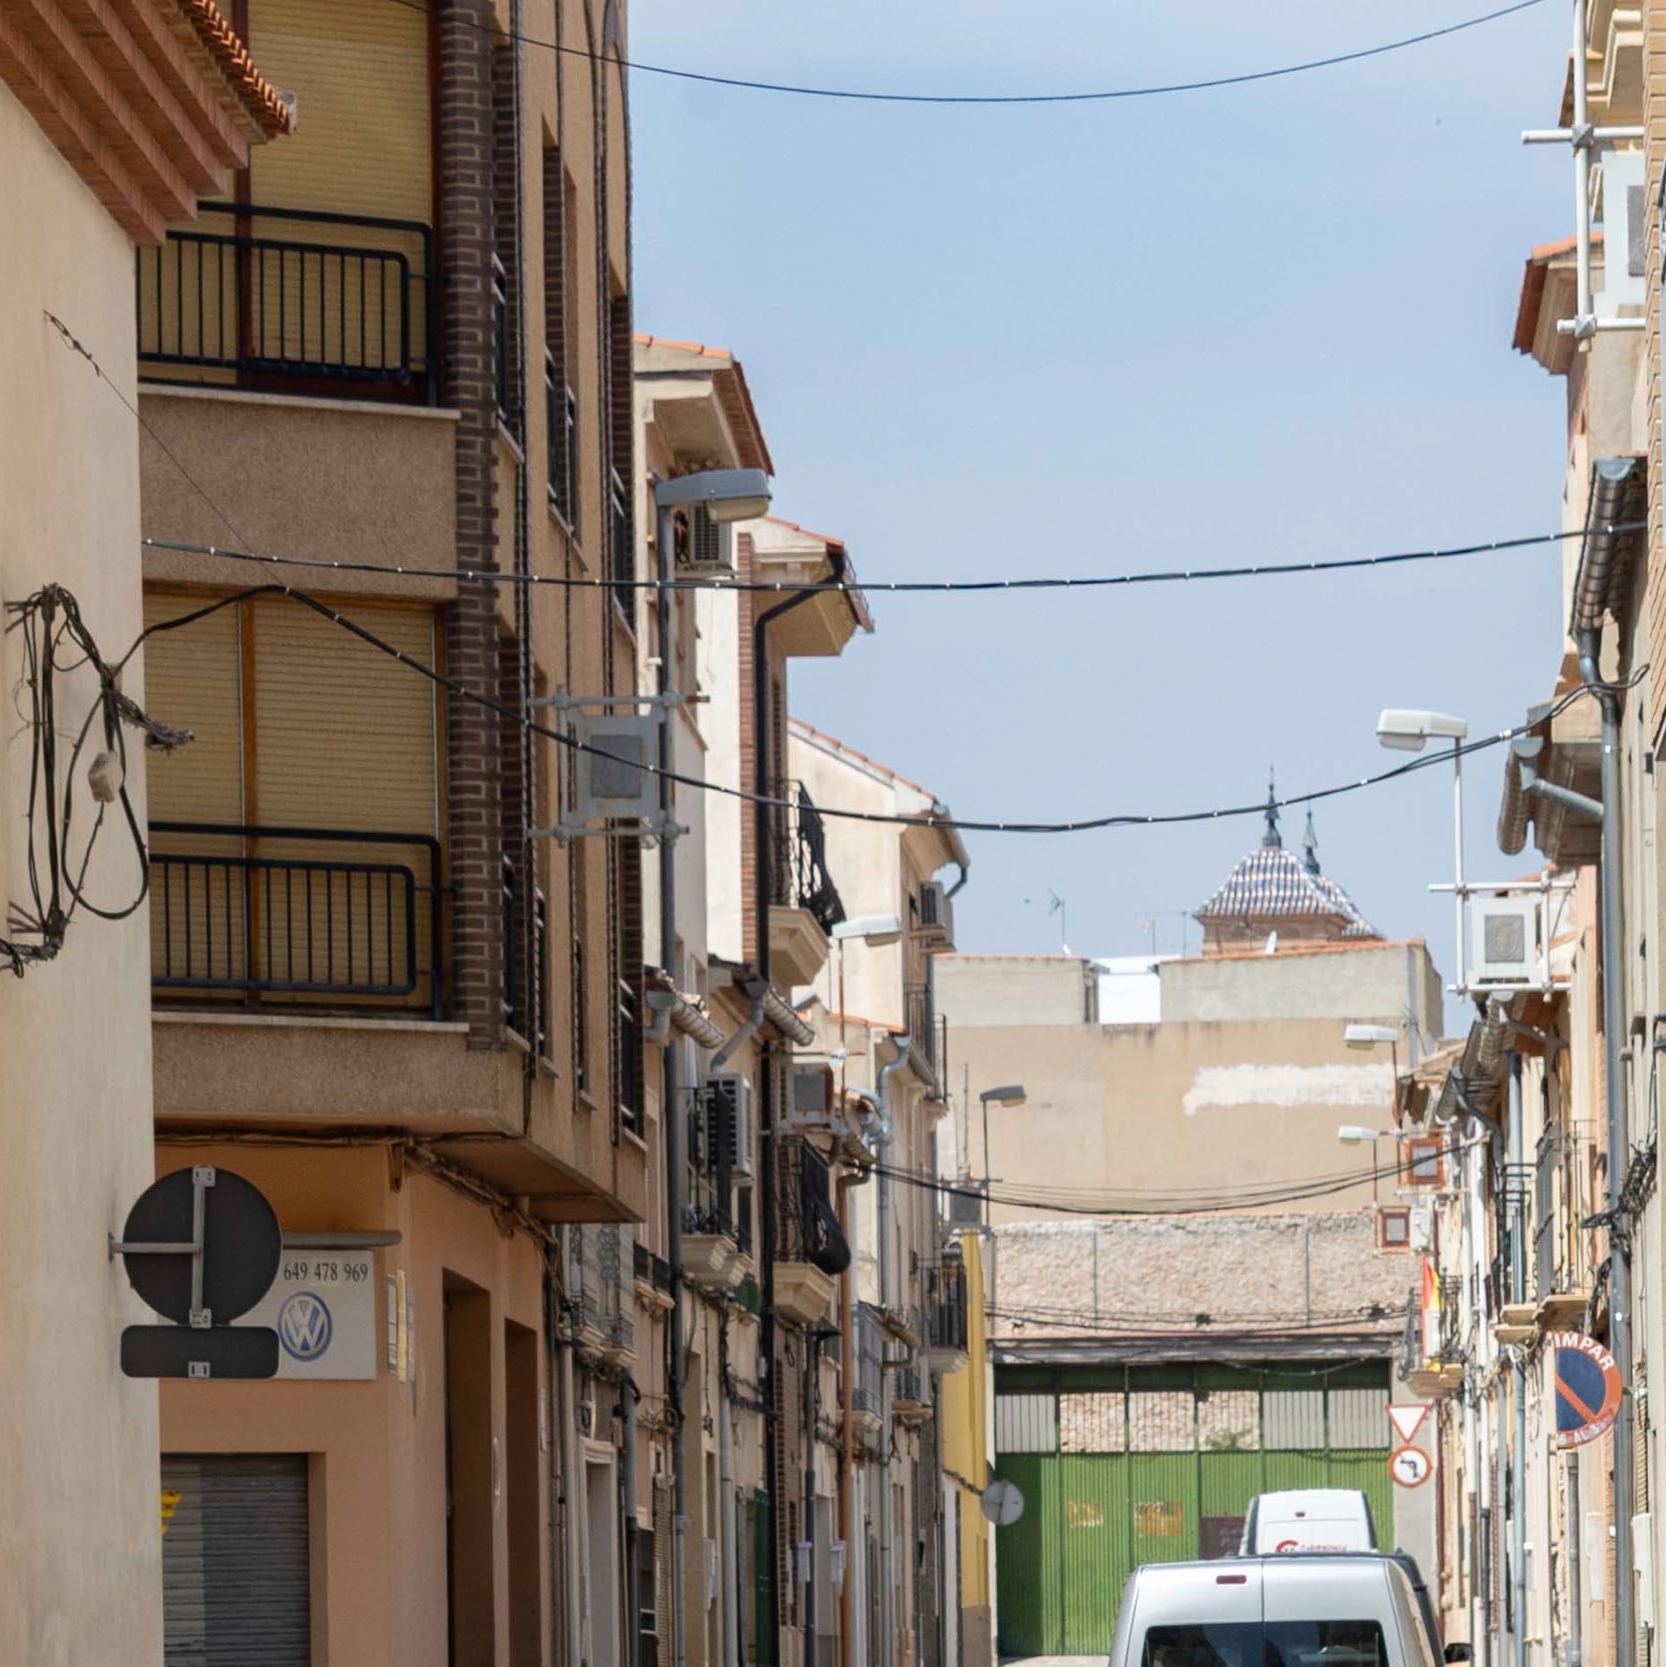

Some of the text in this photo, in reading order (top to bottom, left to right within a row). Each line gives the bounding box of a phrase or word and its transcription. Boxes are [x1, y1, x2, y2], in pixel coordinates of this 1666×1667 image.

[284, 1262, 368, 1282] 649 478 969
[1554, 1332, 1615, 1371] IMPAR
